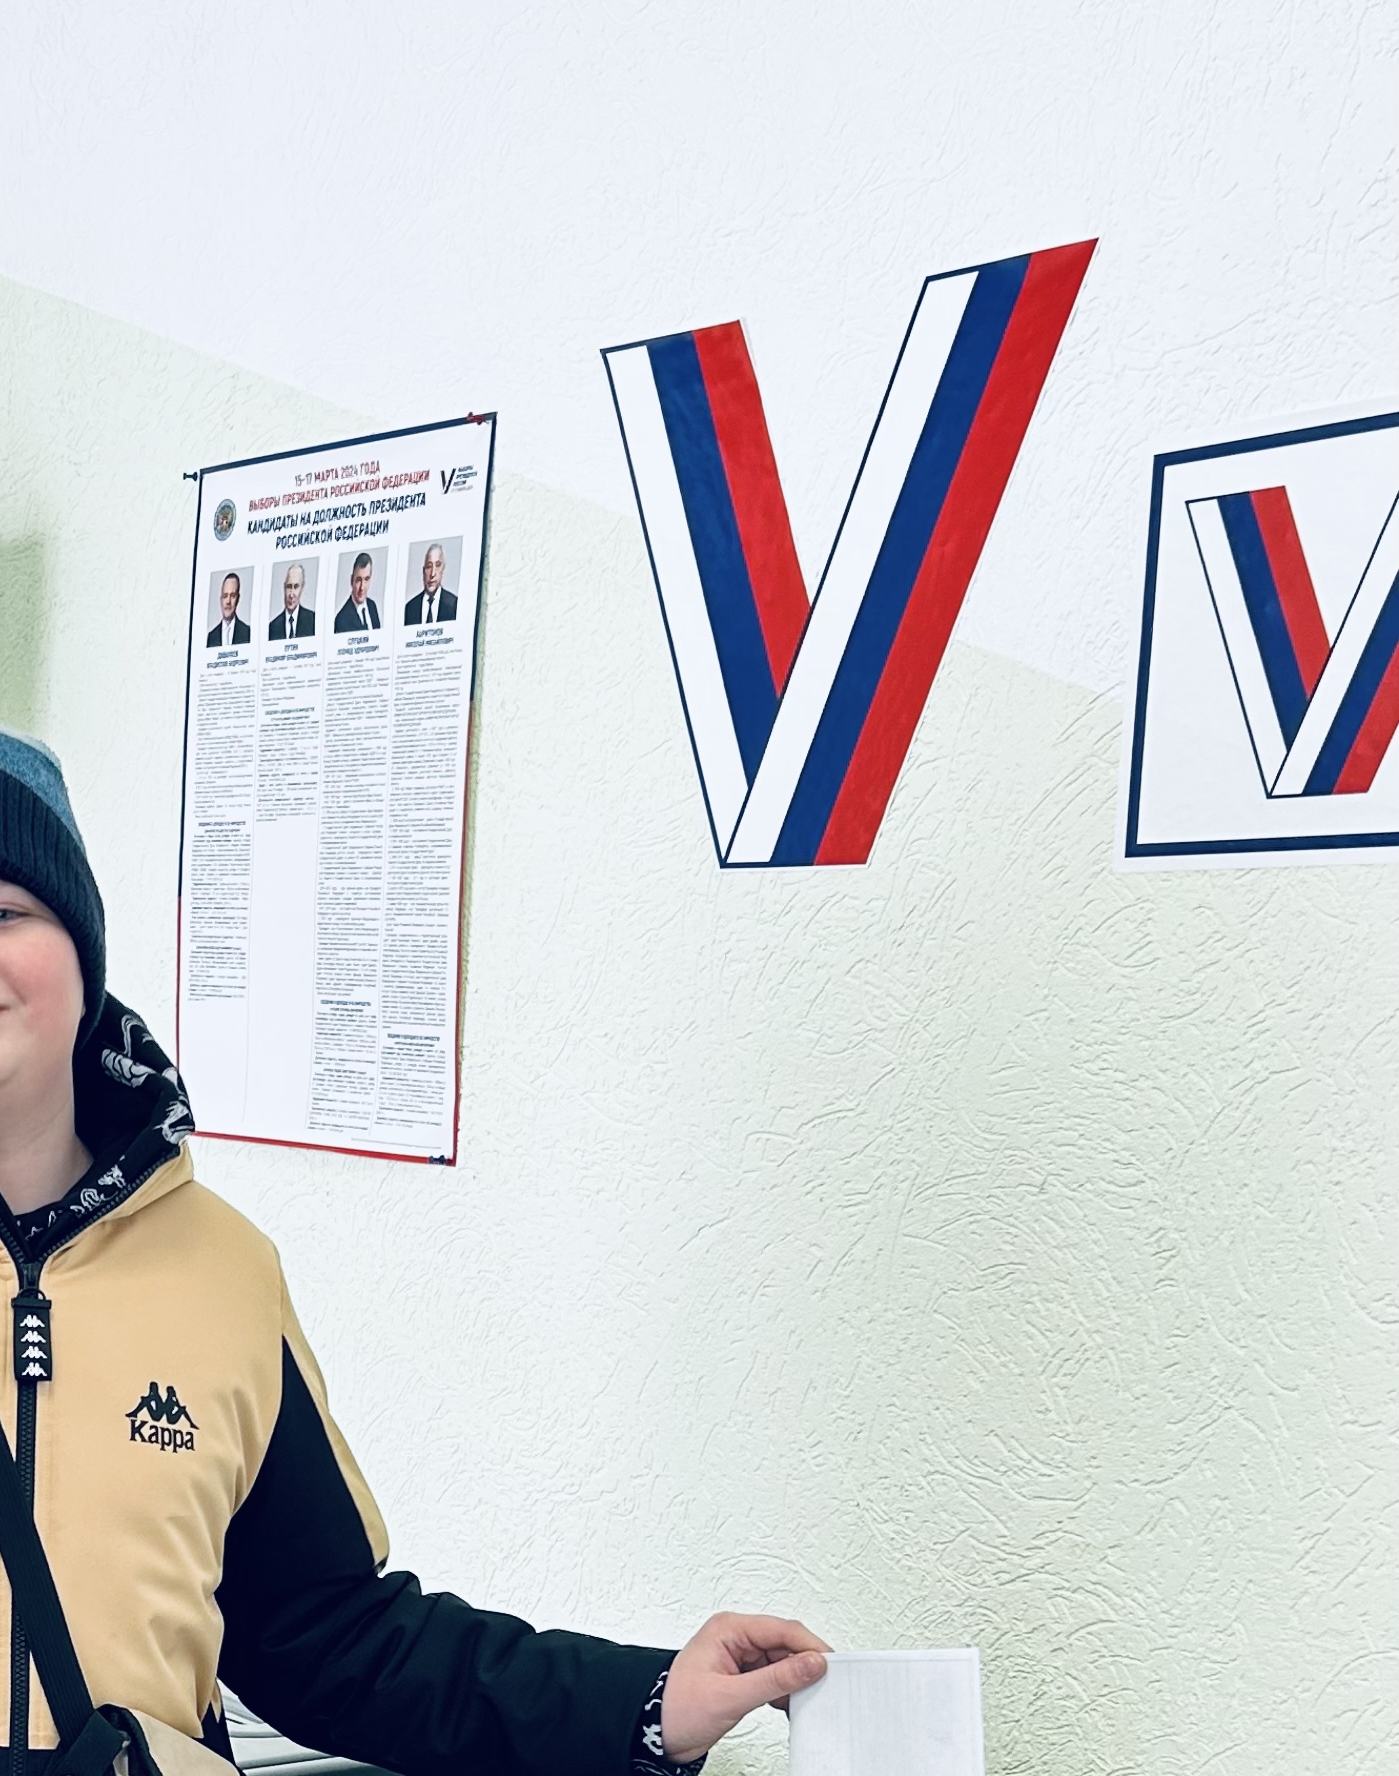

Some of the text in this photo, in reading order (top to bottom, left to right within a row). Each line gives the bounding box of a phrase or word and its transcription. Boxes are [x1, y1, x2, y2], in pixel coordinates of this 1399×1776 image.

[314, 468, 339, 483] МАРТА
[341, 465, 359, 480] 2024
[360, 460, 381, 476] ГОДА
[249, 495, 281, 512] ВЫБОРЫ
[282, 487, 328, 508] ПРЕЗИДЕНТА
[330, 477, 380, 498] РОССИЙСКОЙ
[381, 469, 430, 490] ФЕДЕРАЦИИ
[247, 492, 426, 535] КАНДИДАТЫ НА ДОЛЖНОСТЬ ПРЕЗИДЕНТА
[276, 519, 389, 550] РОССИЙСКОЙ ФЕДЕРАЦИИ
[129, 1418, 196, 1453] Kappa
